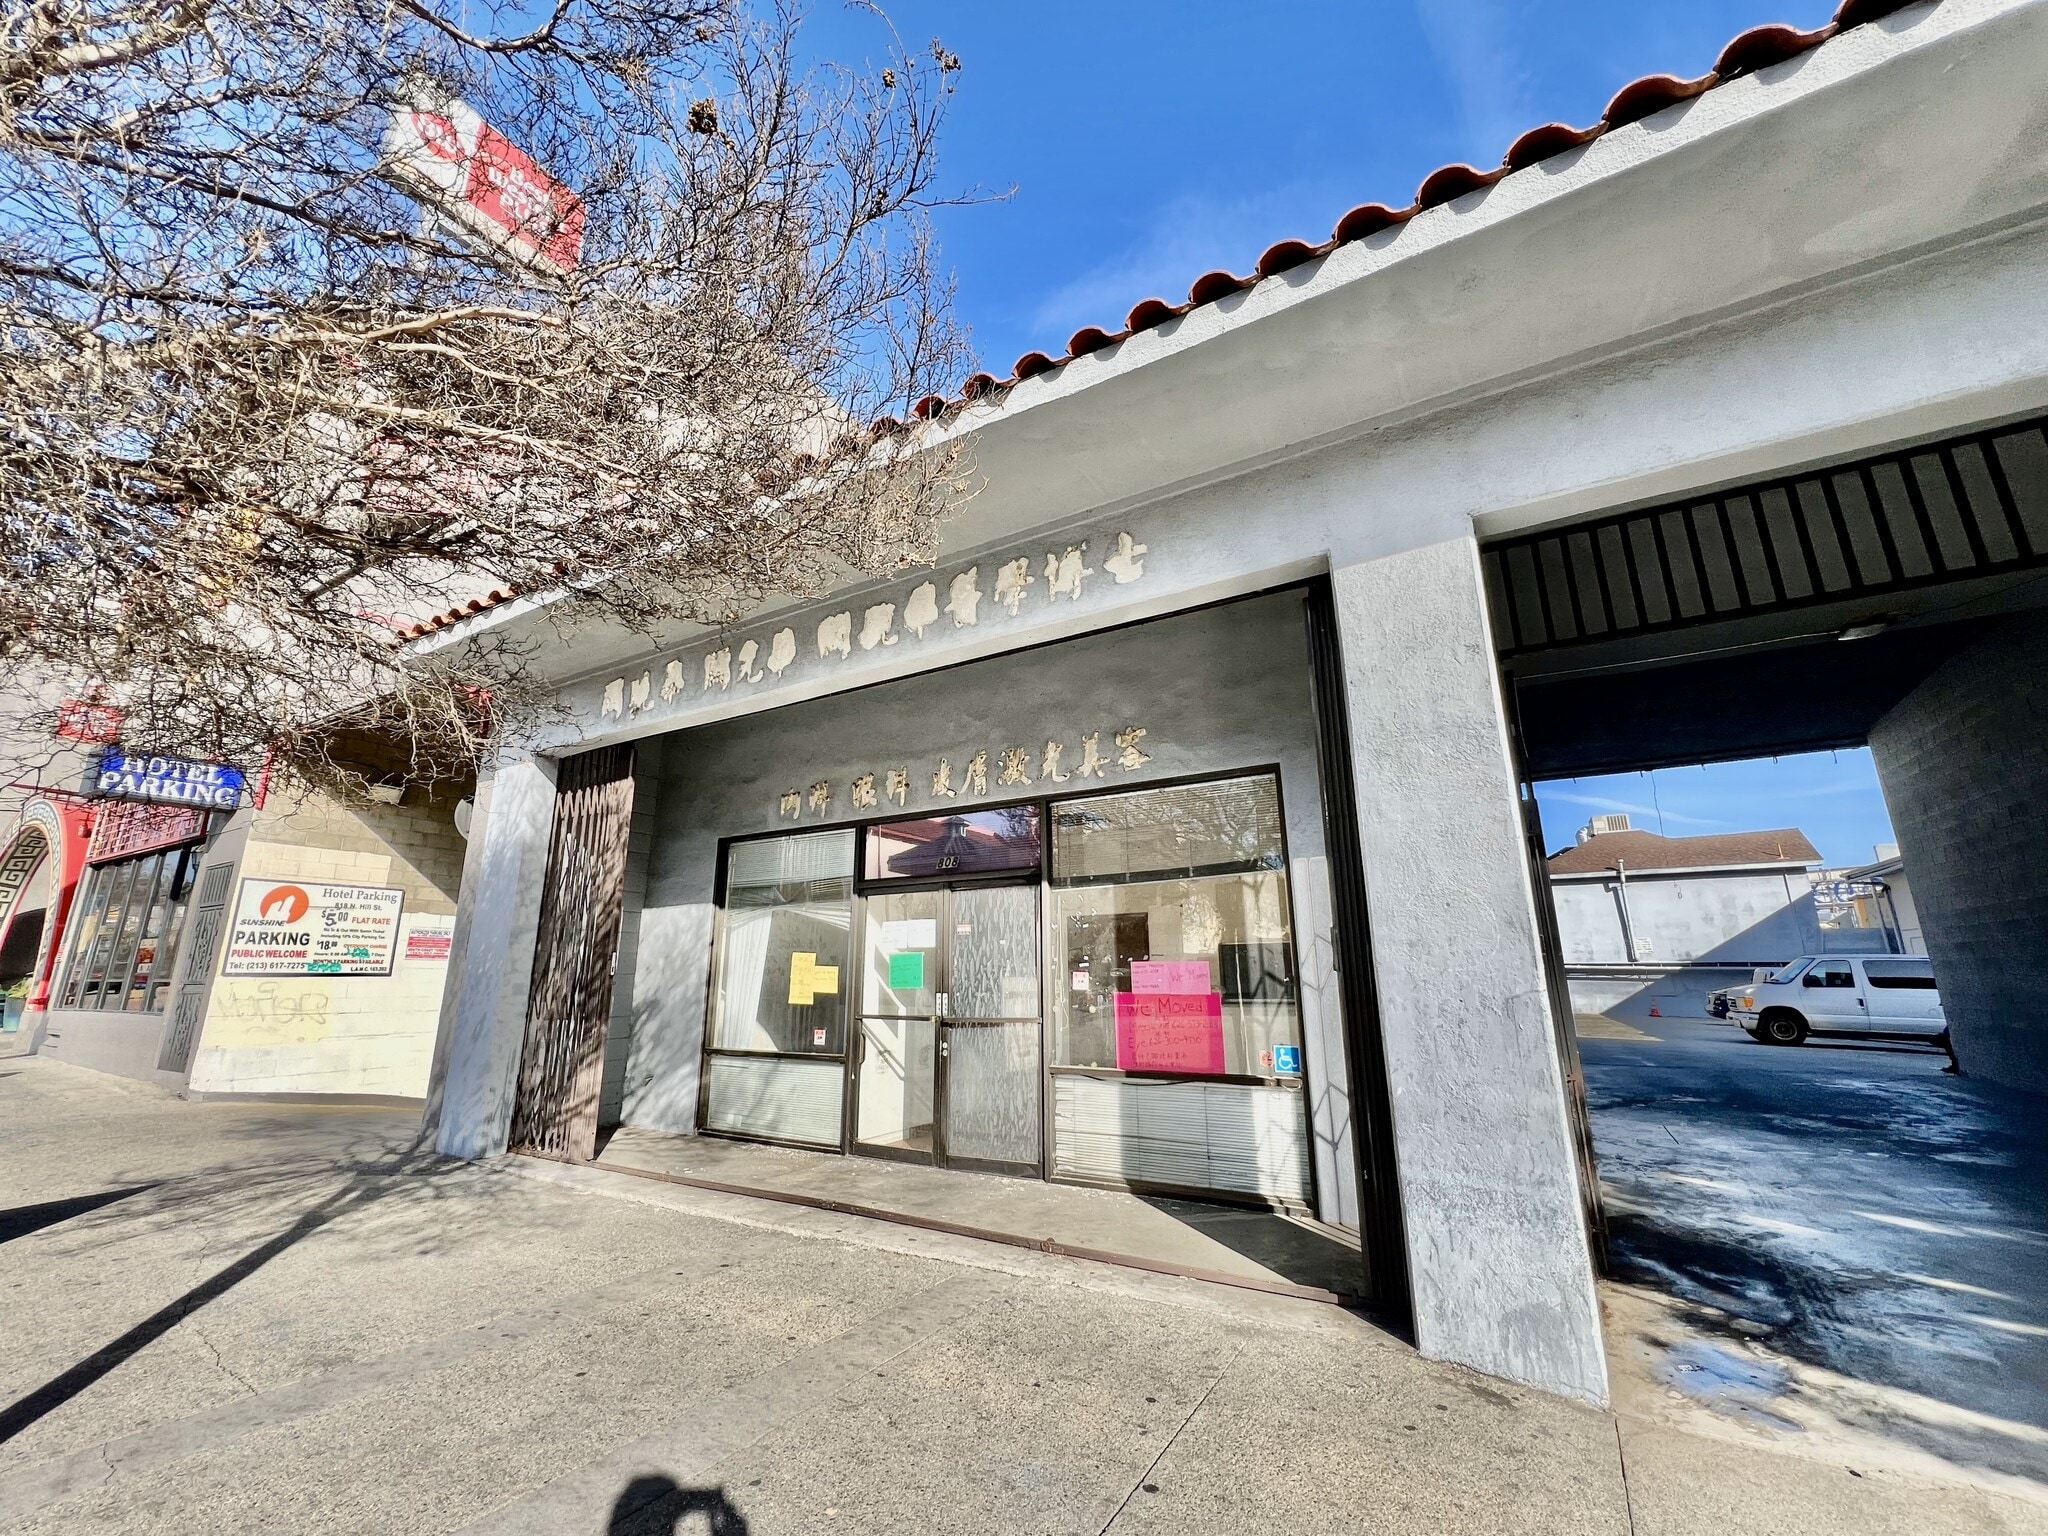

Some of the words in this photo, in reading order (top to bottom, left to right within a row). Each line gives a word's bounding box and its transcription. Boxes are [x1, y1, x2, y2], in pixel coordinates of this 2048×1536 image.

[120, 756, 223, 785] HOTEL
[97, 771, 234, 805] PARKING
[938, 857, 959, 868] 808
[322, 888, 353, 900] Hotel
[356, 890, 398, 904] Parking
[239, 918, 286, 927] SUNSHINE
[351, 916, 371, 924] FLAT
[371, 918, 391, 926] RATE
[233, 930, 311, 946] PARKING
[230, 949, 264, 958] PUBLIC
[265, 949, 308, 958] WELCOME
[246, 962, 268, 971] (213)
[269, 962, 306, 970] 617-7275
[1127, 999, 1151, 1017] We
[1158, 997, 1203, 1014] Moved
